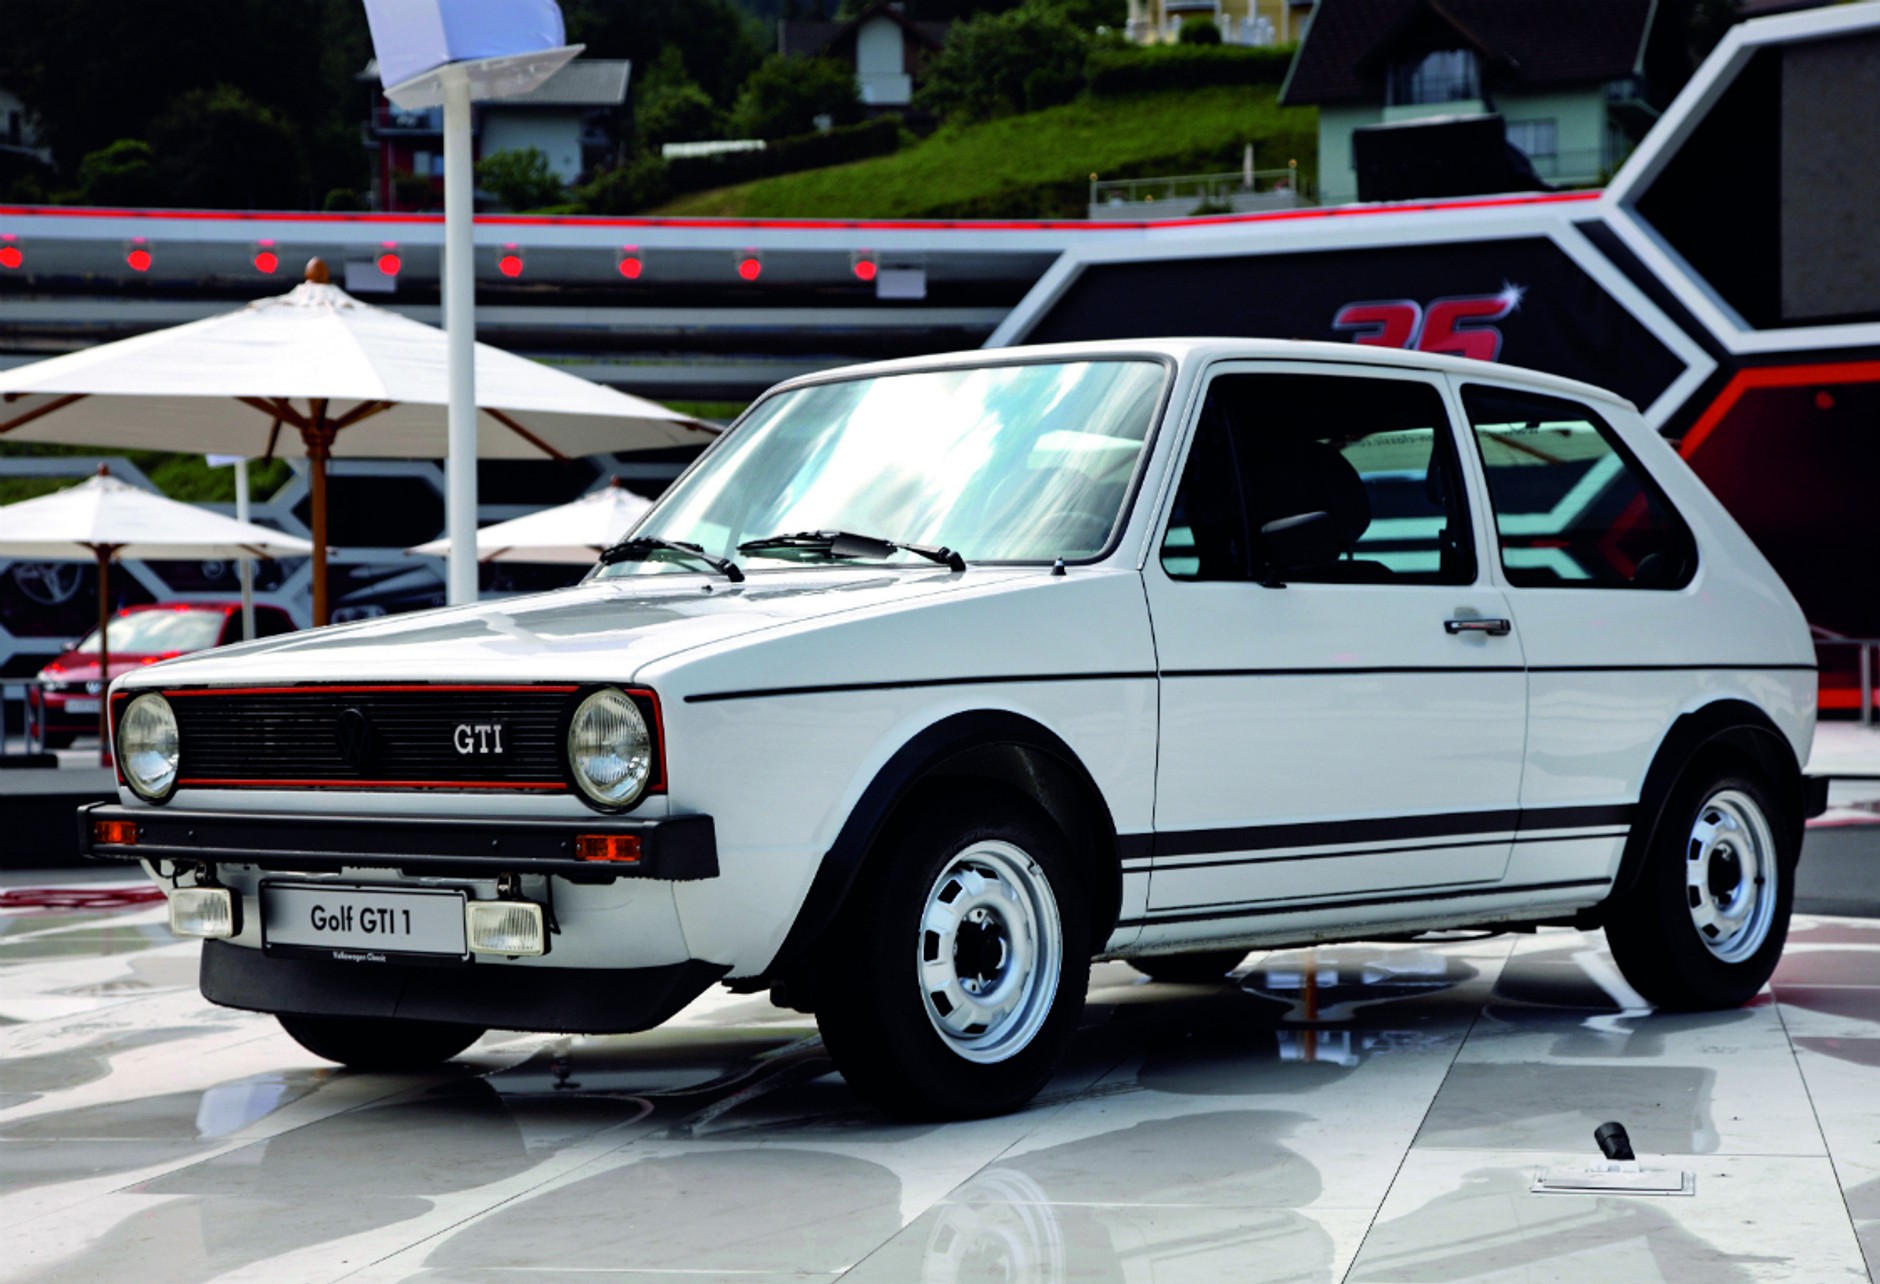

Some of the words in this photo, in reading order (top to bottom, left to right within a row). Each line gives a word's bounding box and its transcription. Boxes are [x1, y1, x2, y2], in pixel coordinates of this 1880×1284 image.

[453, 723, 503, 755] GTI
[310, 904, 353, 932] Golf
[360, 906, 395, 934] GTI
[402, 909, 411, 935] 1
